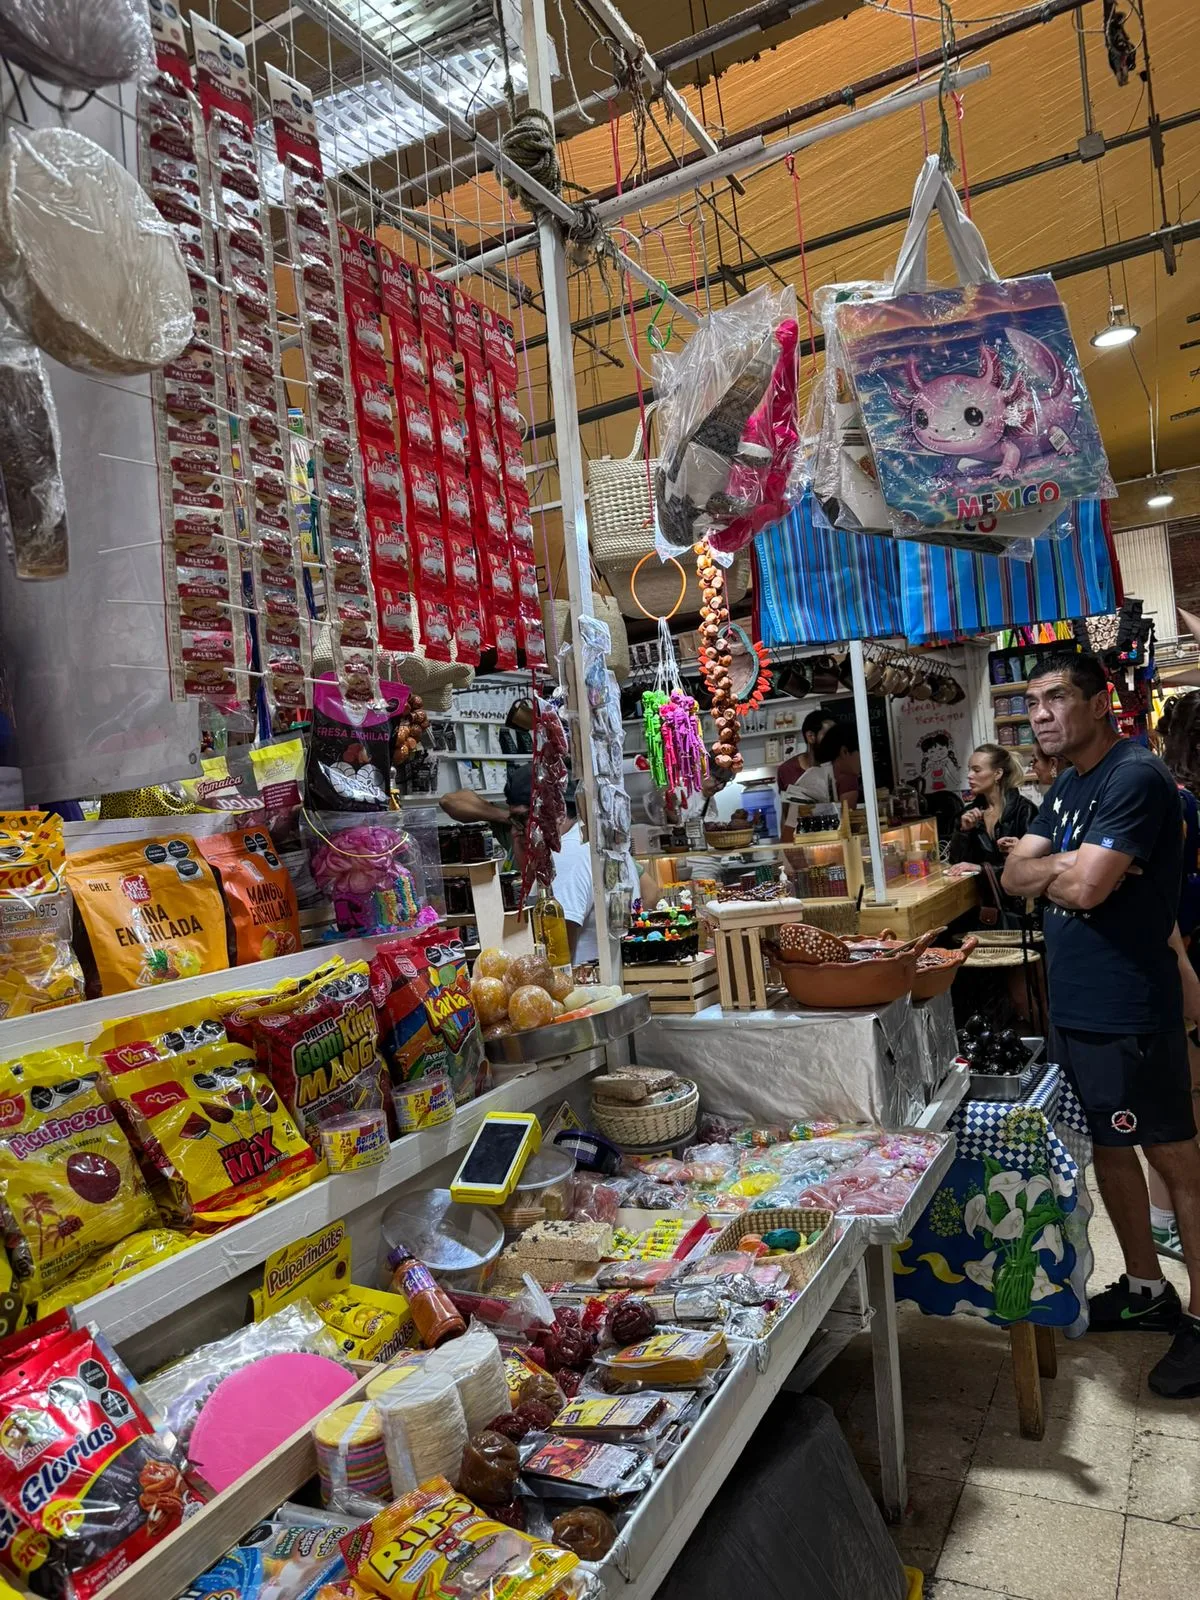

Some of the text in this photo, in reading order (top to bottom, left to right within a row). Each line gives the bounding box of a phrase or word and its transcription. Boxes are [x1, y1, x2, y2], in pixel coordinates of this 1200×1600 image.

[957, 480, 1061, 521] MEXICO
[316, 727, 348, 738] FRESA
[197, 774, 244, 798] Jamaica
[88, 882, 112, 892] CHILE
[246, 882, 284, 906] MANGO
[34, 904, 58, 918] 1975
[131, 904, 168, 926] IÑA
[115, 914, 204, 948] ENHILADA
[426, 990, 469, 1029] Karla
[304, 1018, 336, 1042] PALETA
[294, 1031, 344, 1077] Gomi
[302, 1096, 328, 1116] Gomita
[414, 1096, 426, 1108] 24
[8, 1104, 114, 1161] PicaFresa
[340, 1136, 353, 1148] 24
[220, 1139, 248, 1160] VERO
[268, 1226, 345, 1297] Pulparindots
[20, 1422, 117, 1514] Glorias
[368, 1497, 476, 1584] RIPS
